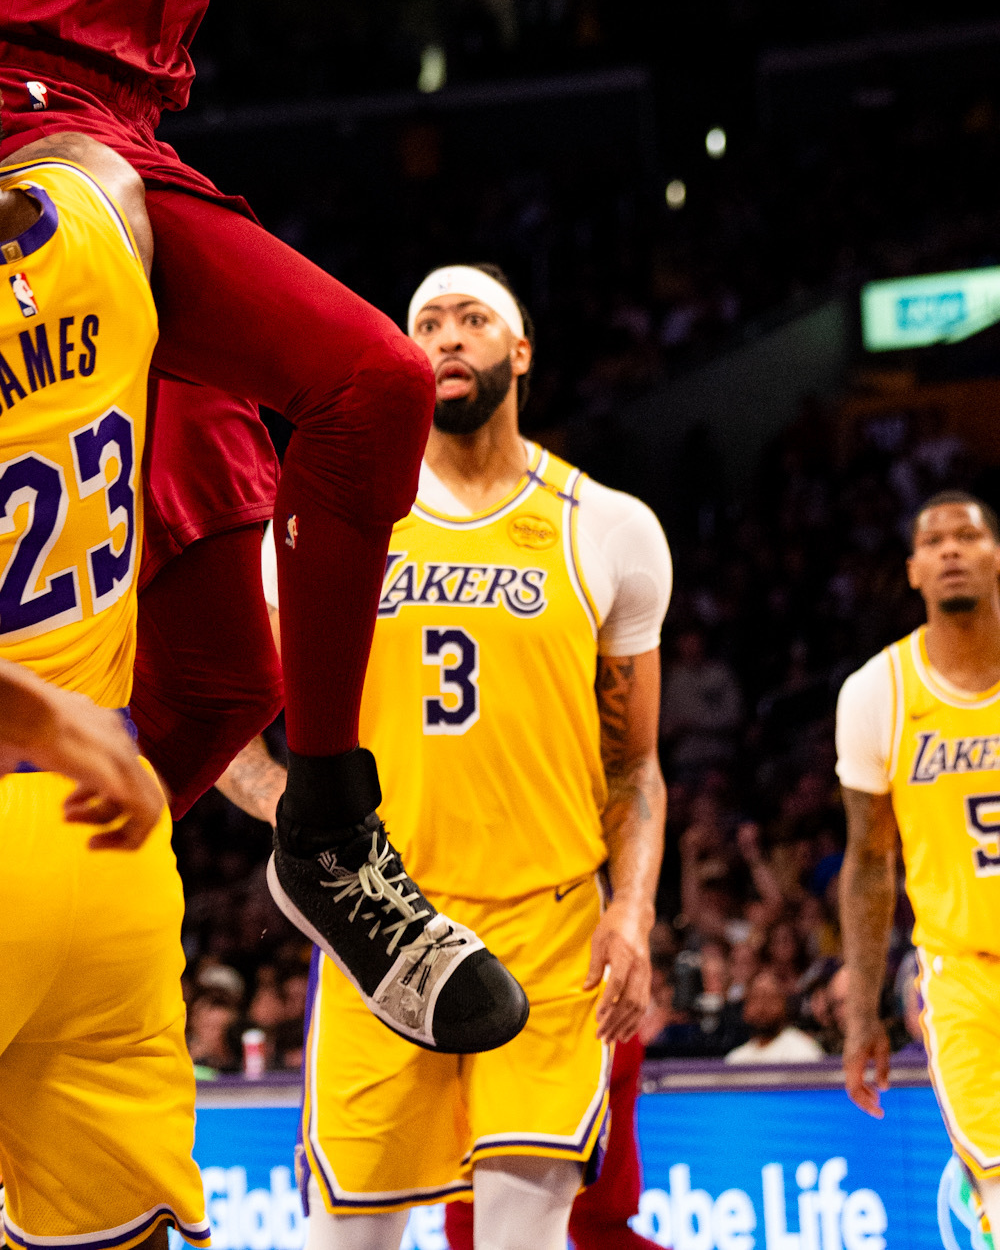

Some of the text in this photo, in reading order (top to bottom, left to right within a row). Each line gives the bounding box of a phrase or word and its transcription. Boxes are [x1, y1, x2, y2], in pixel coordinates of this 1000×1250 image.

[421, 626, 480, 735] 3
[907, 730, 1000, 786] LAKE
[963, 791, 1000, 878] 5
[200, 1165, 308, 1250] Glob
[628, 1156, 888, 1250] obe Life
